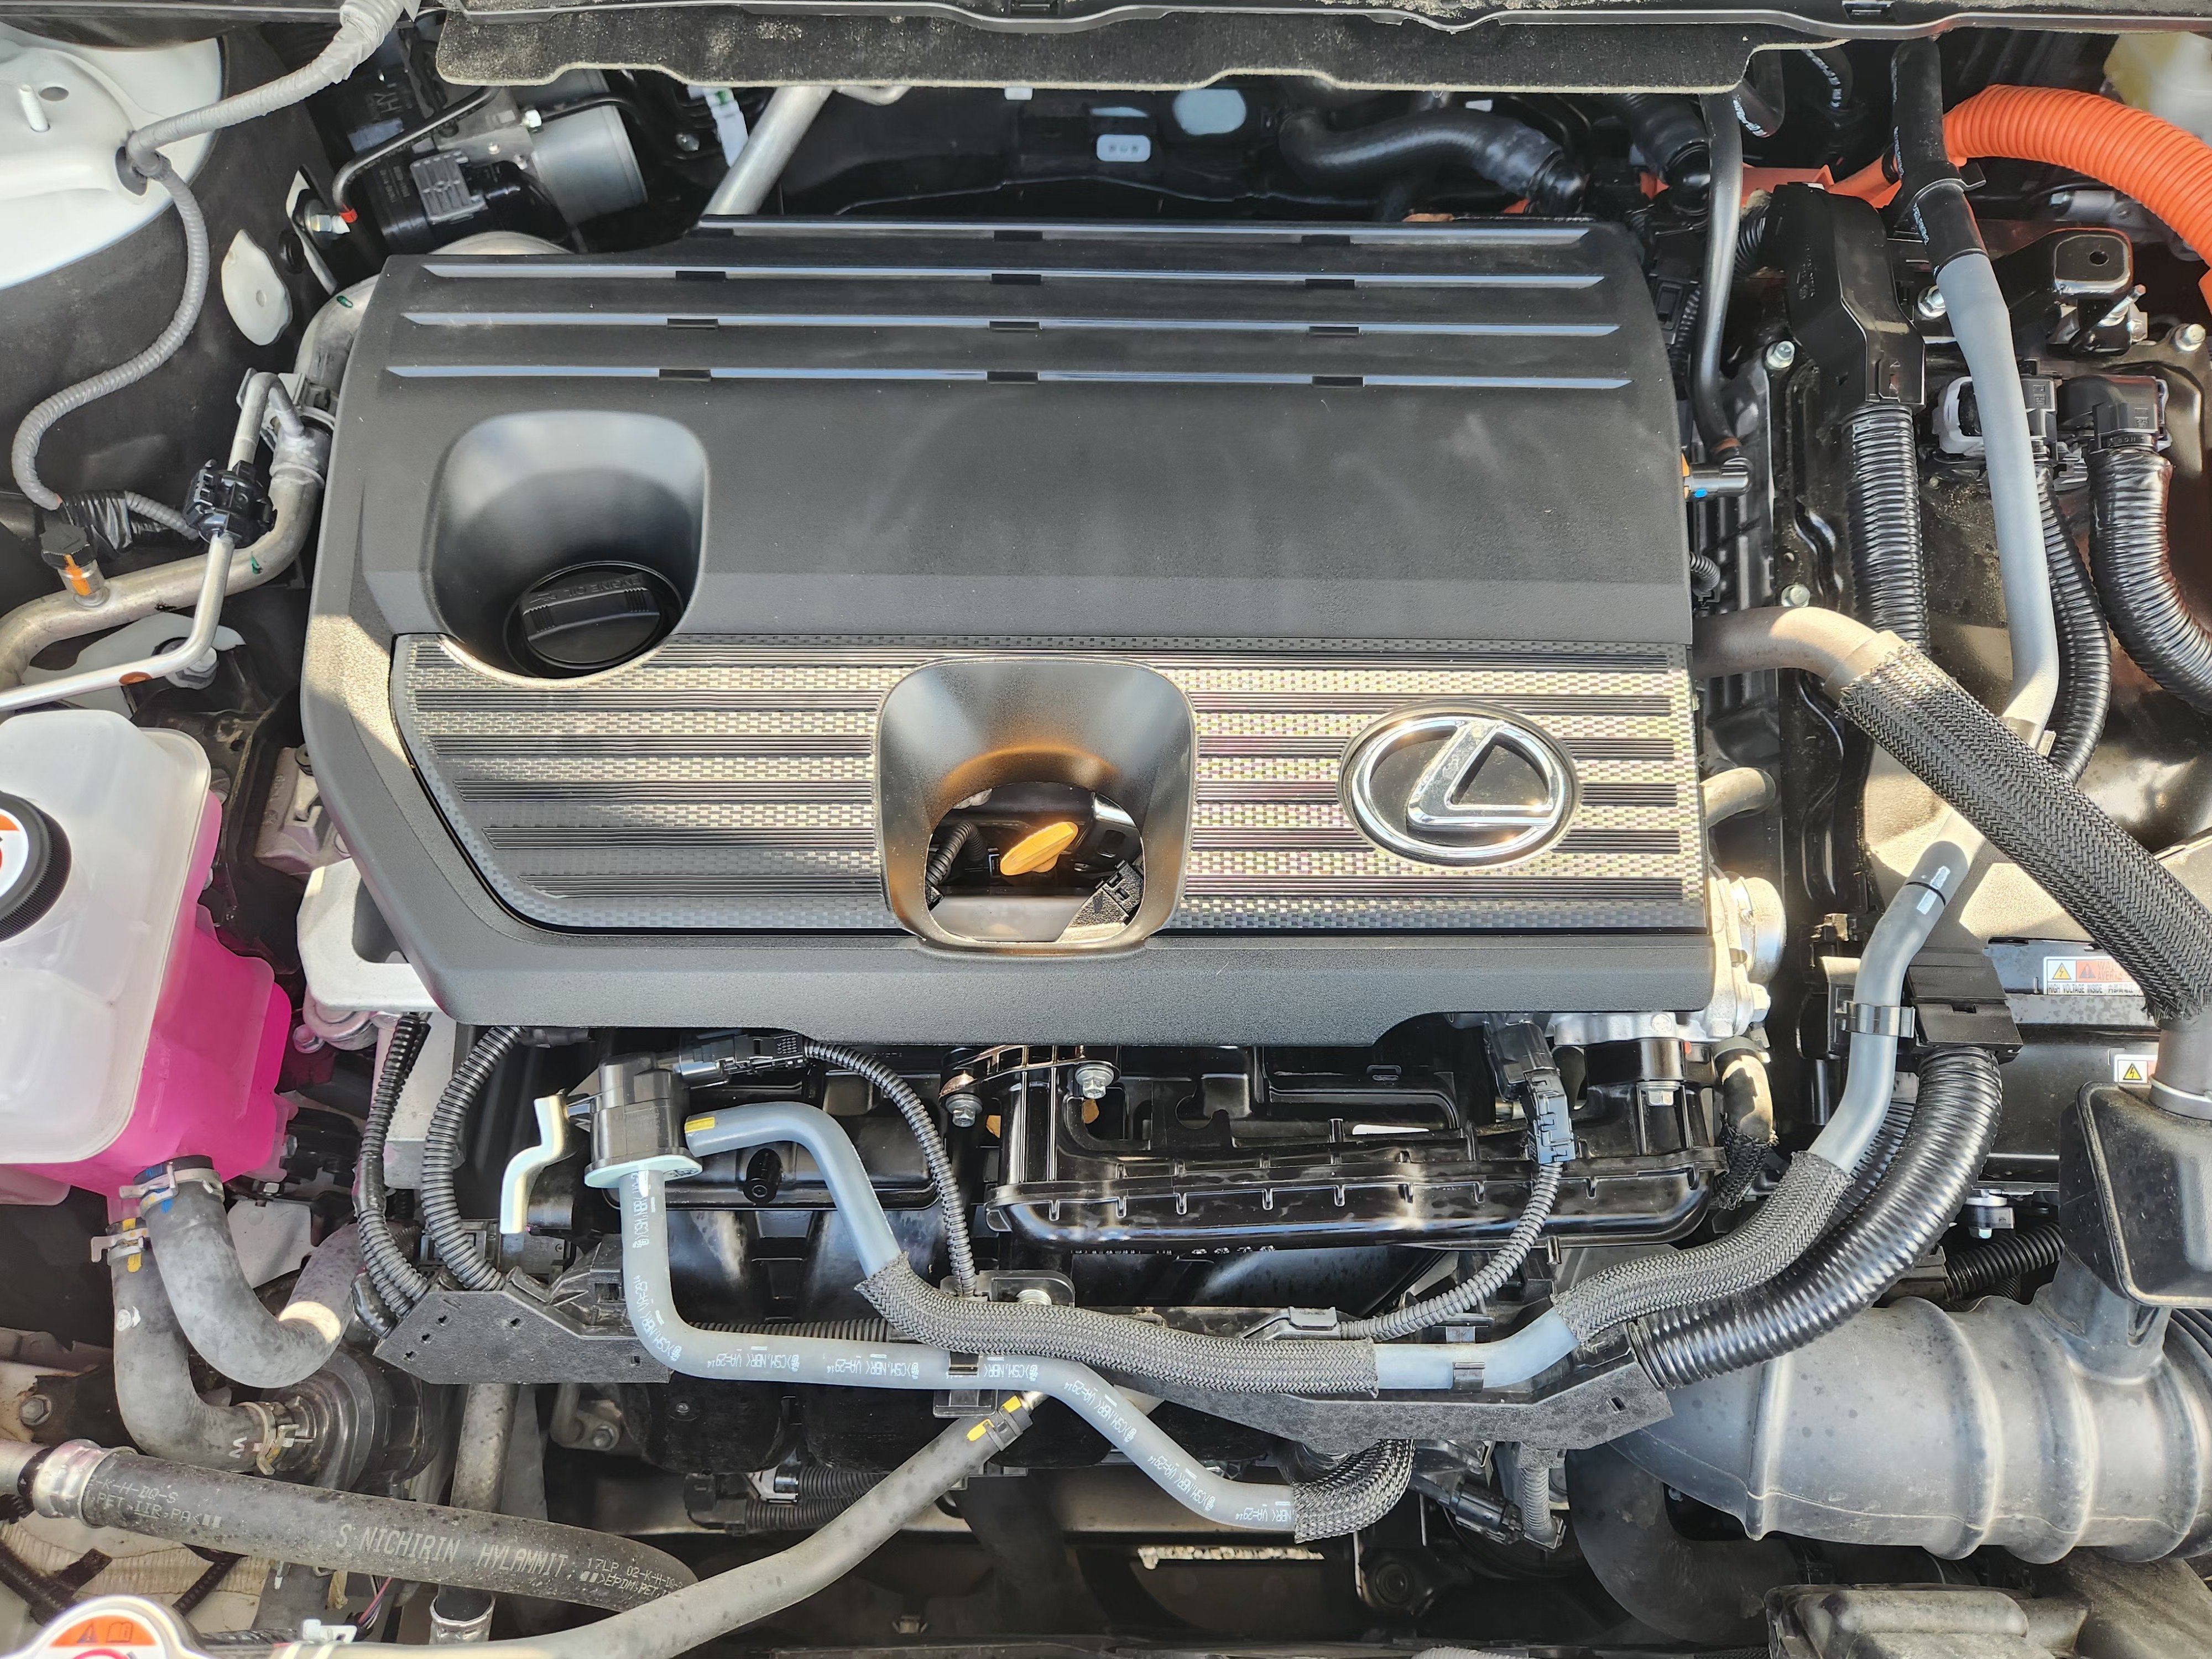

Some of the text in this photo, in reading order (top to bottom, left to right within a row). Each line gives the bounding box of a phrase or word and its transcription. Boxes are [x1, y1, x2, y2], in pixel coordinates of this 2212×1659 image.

[565, 577, 641, 597] ENGINE OIL
[2048, 984, 2103, 994] HIGH VOLTAGE INSIDE
[359, 1526, 461, 1563] NICHIRIN
[476, 1543, 568, 1577] HYLAMMIT
